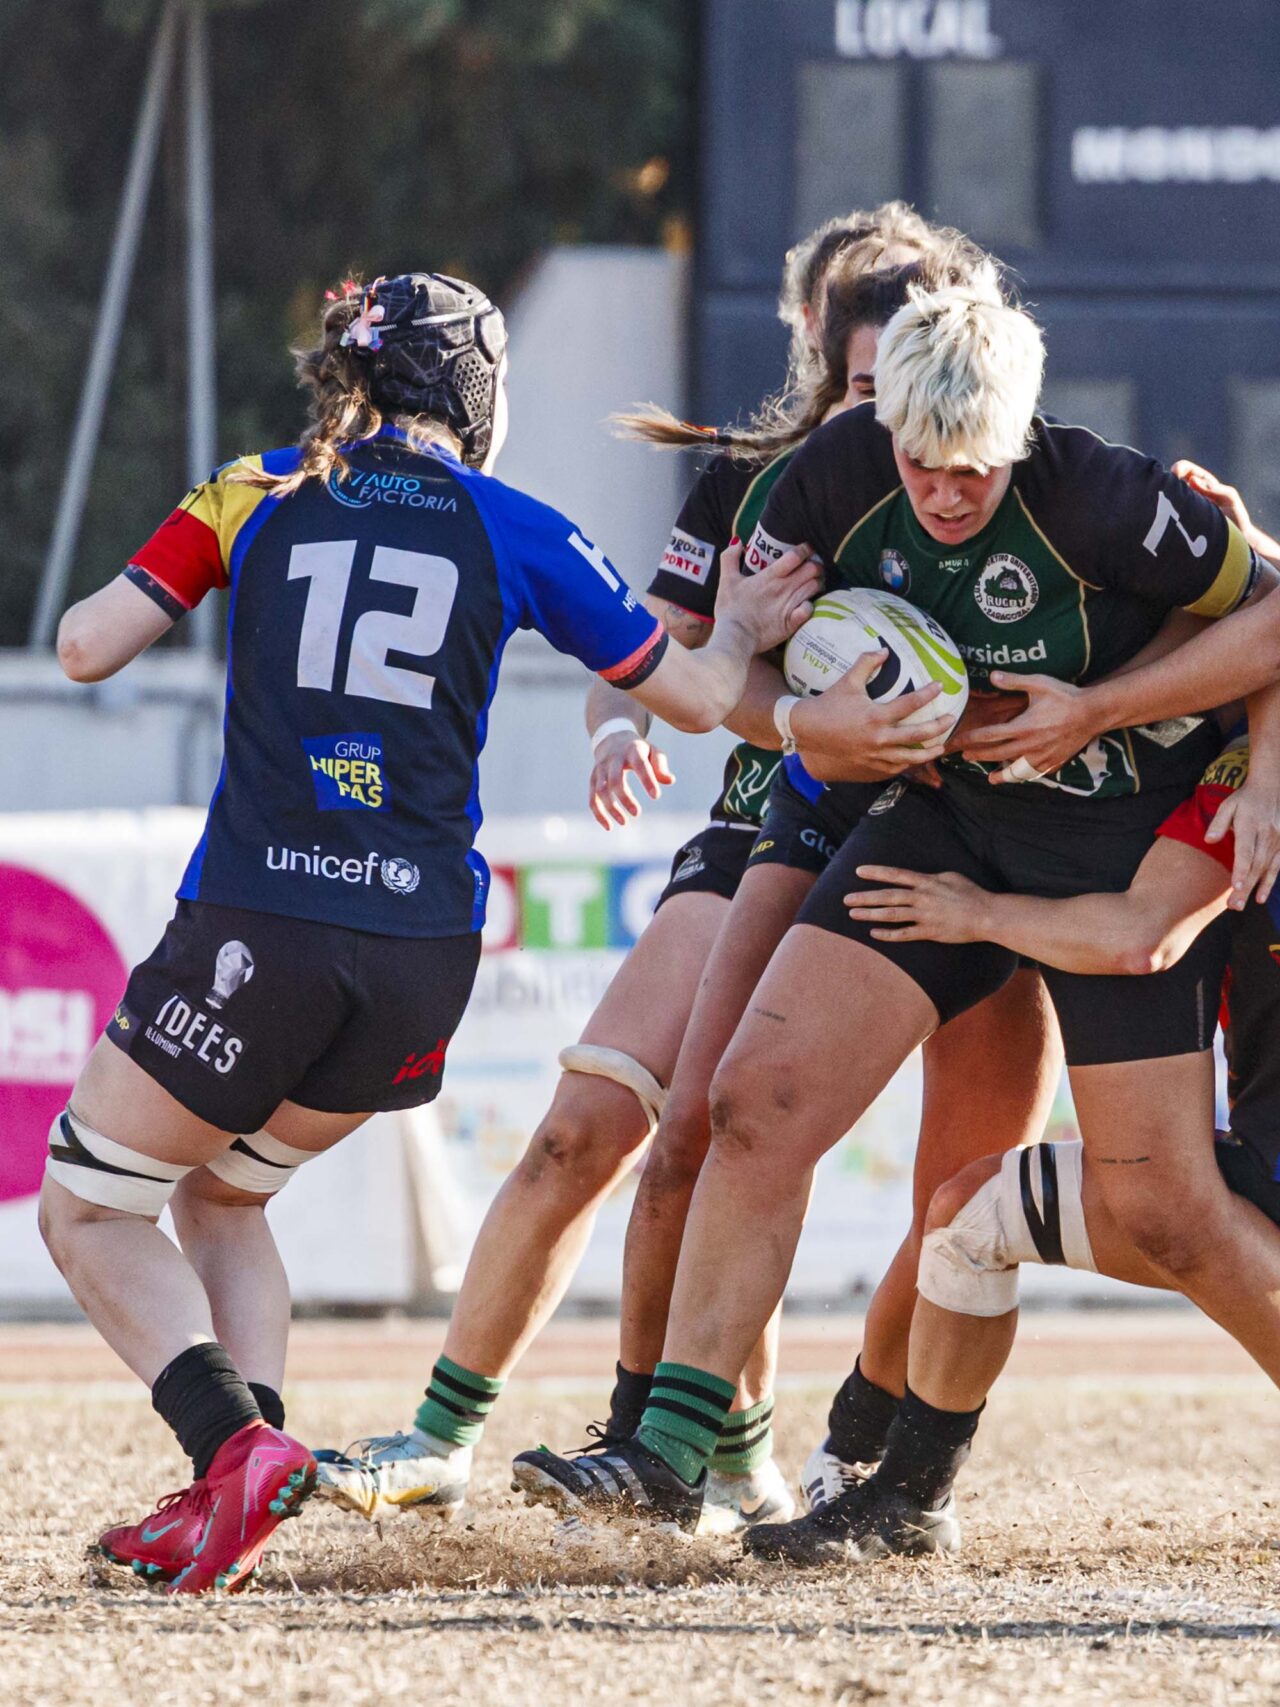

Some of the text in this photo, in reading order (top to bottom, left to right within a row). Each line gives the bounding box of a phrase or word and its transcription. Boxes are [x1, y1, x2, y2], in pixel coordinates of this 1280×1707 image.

[834, 0, 996, 58] LOCAL
[364, 473, 421, 492] AUTO
[359, 486, 457, 513] FACTORIA
[1142, 490, 1208, 558] 7
[986, 595, 1026, 608] RUGBY
[287, 539, 459, 710] 12
[334, 741, 381, 761] GRUP
[309, 754, 383, 786] HIPER
[337, 780, 384, 809] PAS
[266, 845, 380, 886] unicef
[155, 994, 243, 1074] IDEES
